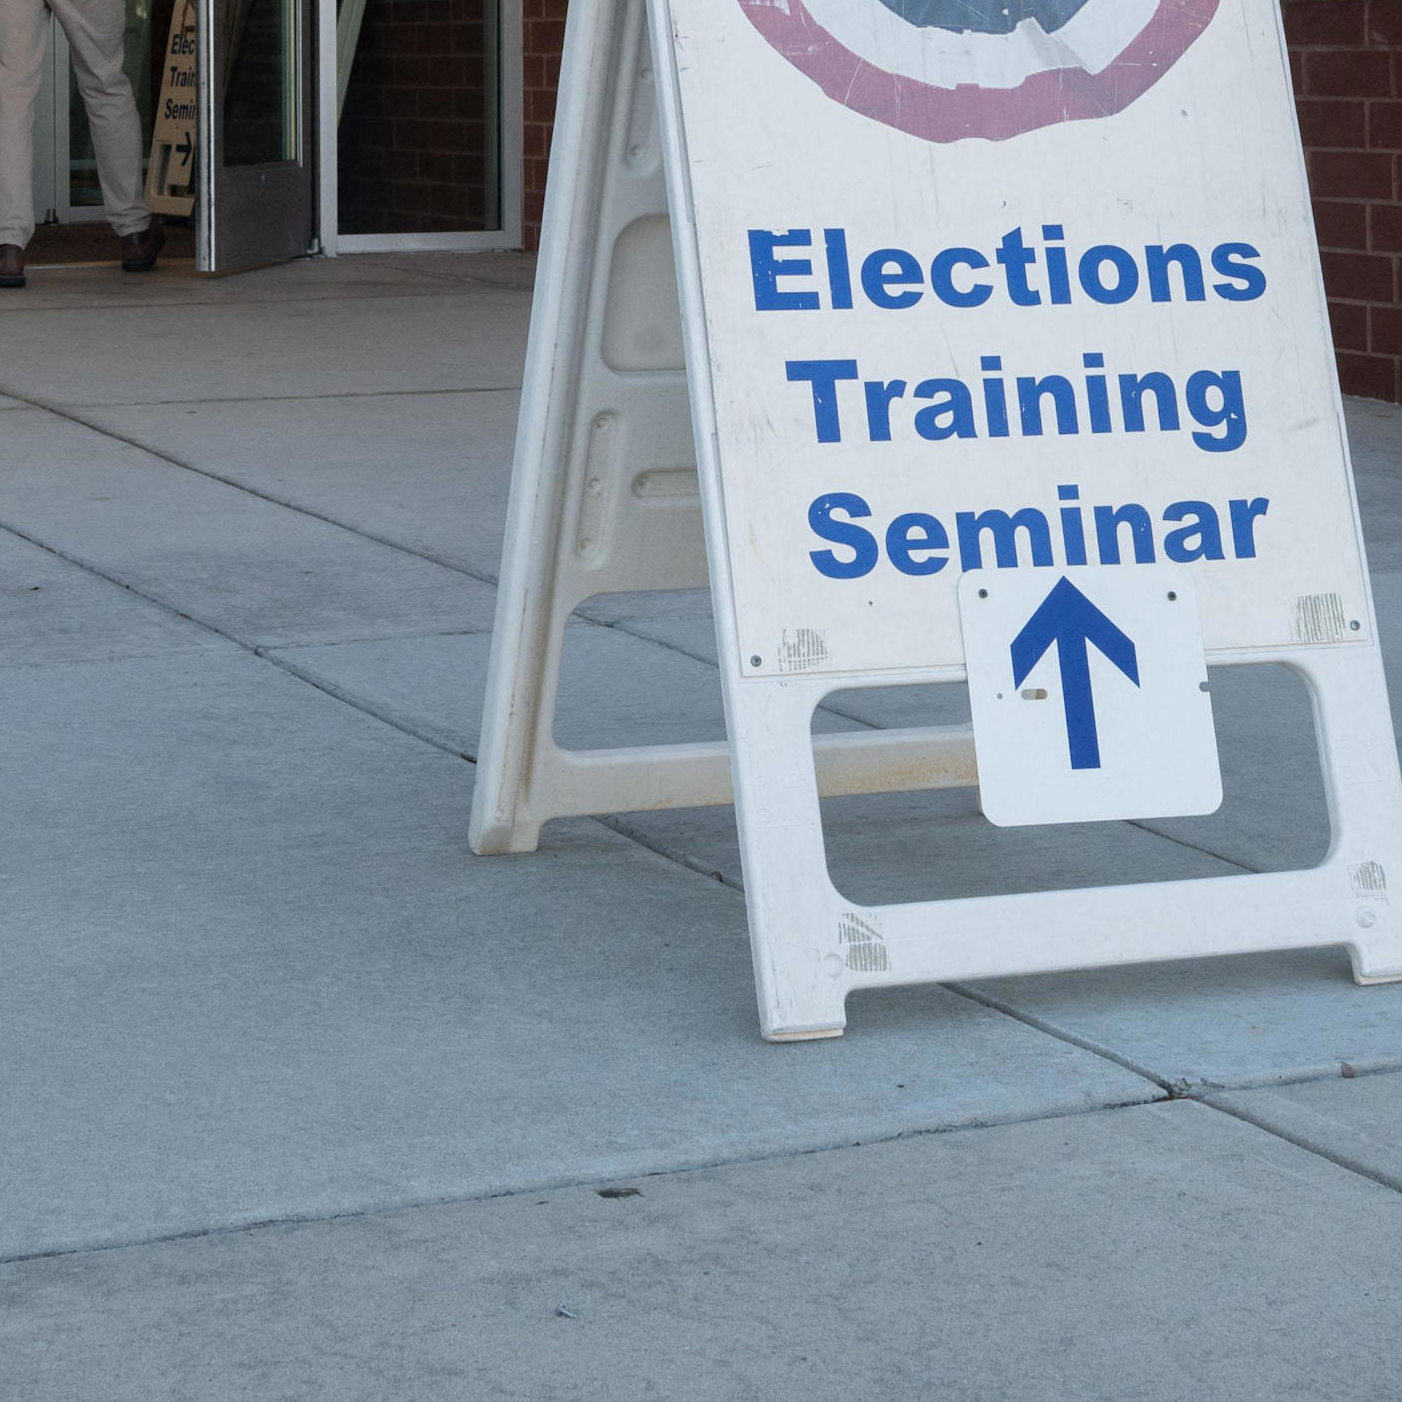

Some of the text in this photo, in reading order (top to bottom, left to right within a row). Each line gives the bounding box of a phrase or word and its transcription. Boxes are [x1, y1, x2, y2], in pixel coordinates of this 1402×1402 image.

[747, 224, 1267, 312] Elections
[785, 352, 1247, 453] Training
[807, 484, 1270, 580] Seminar
